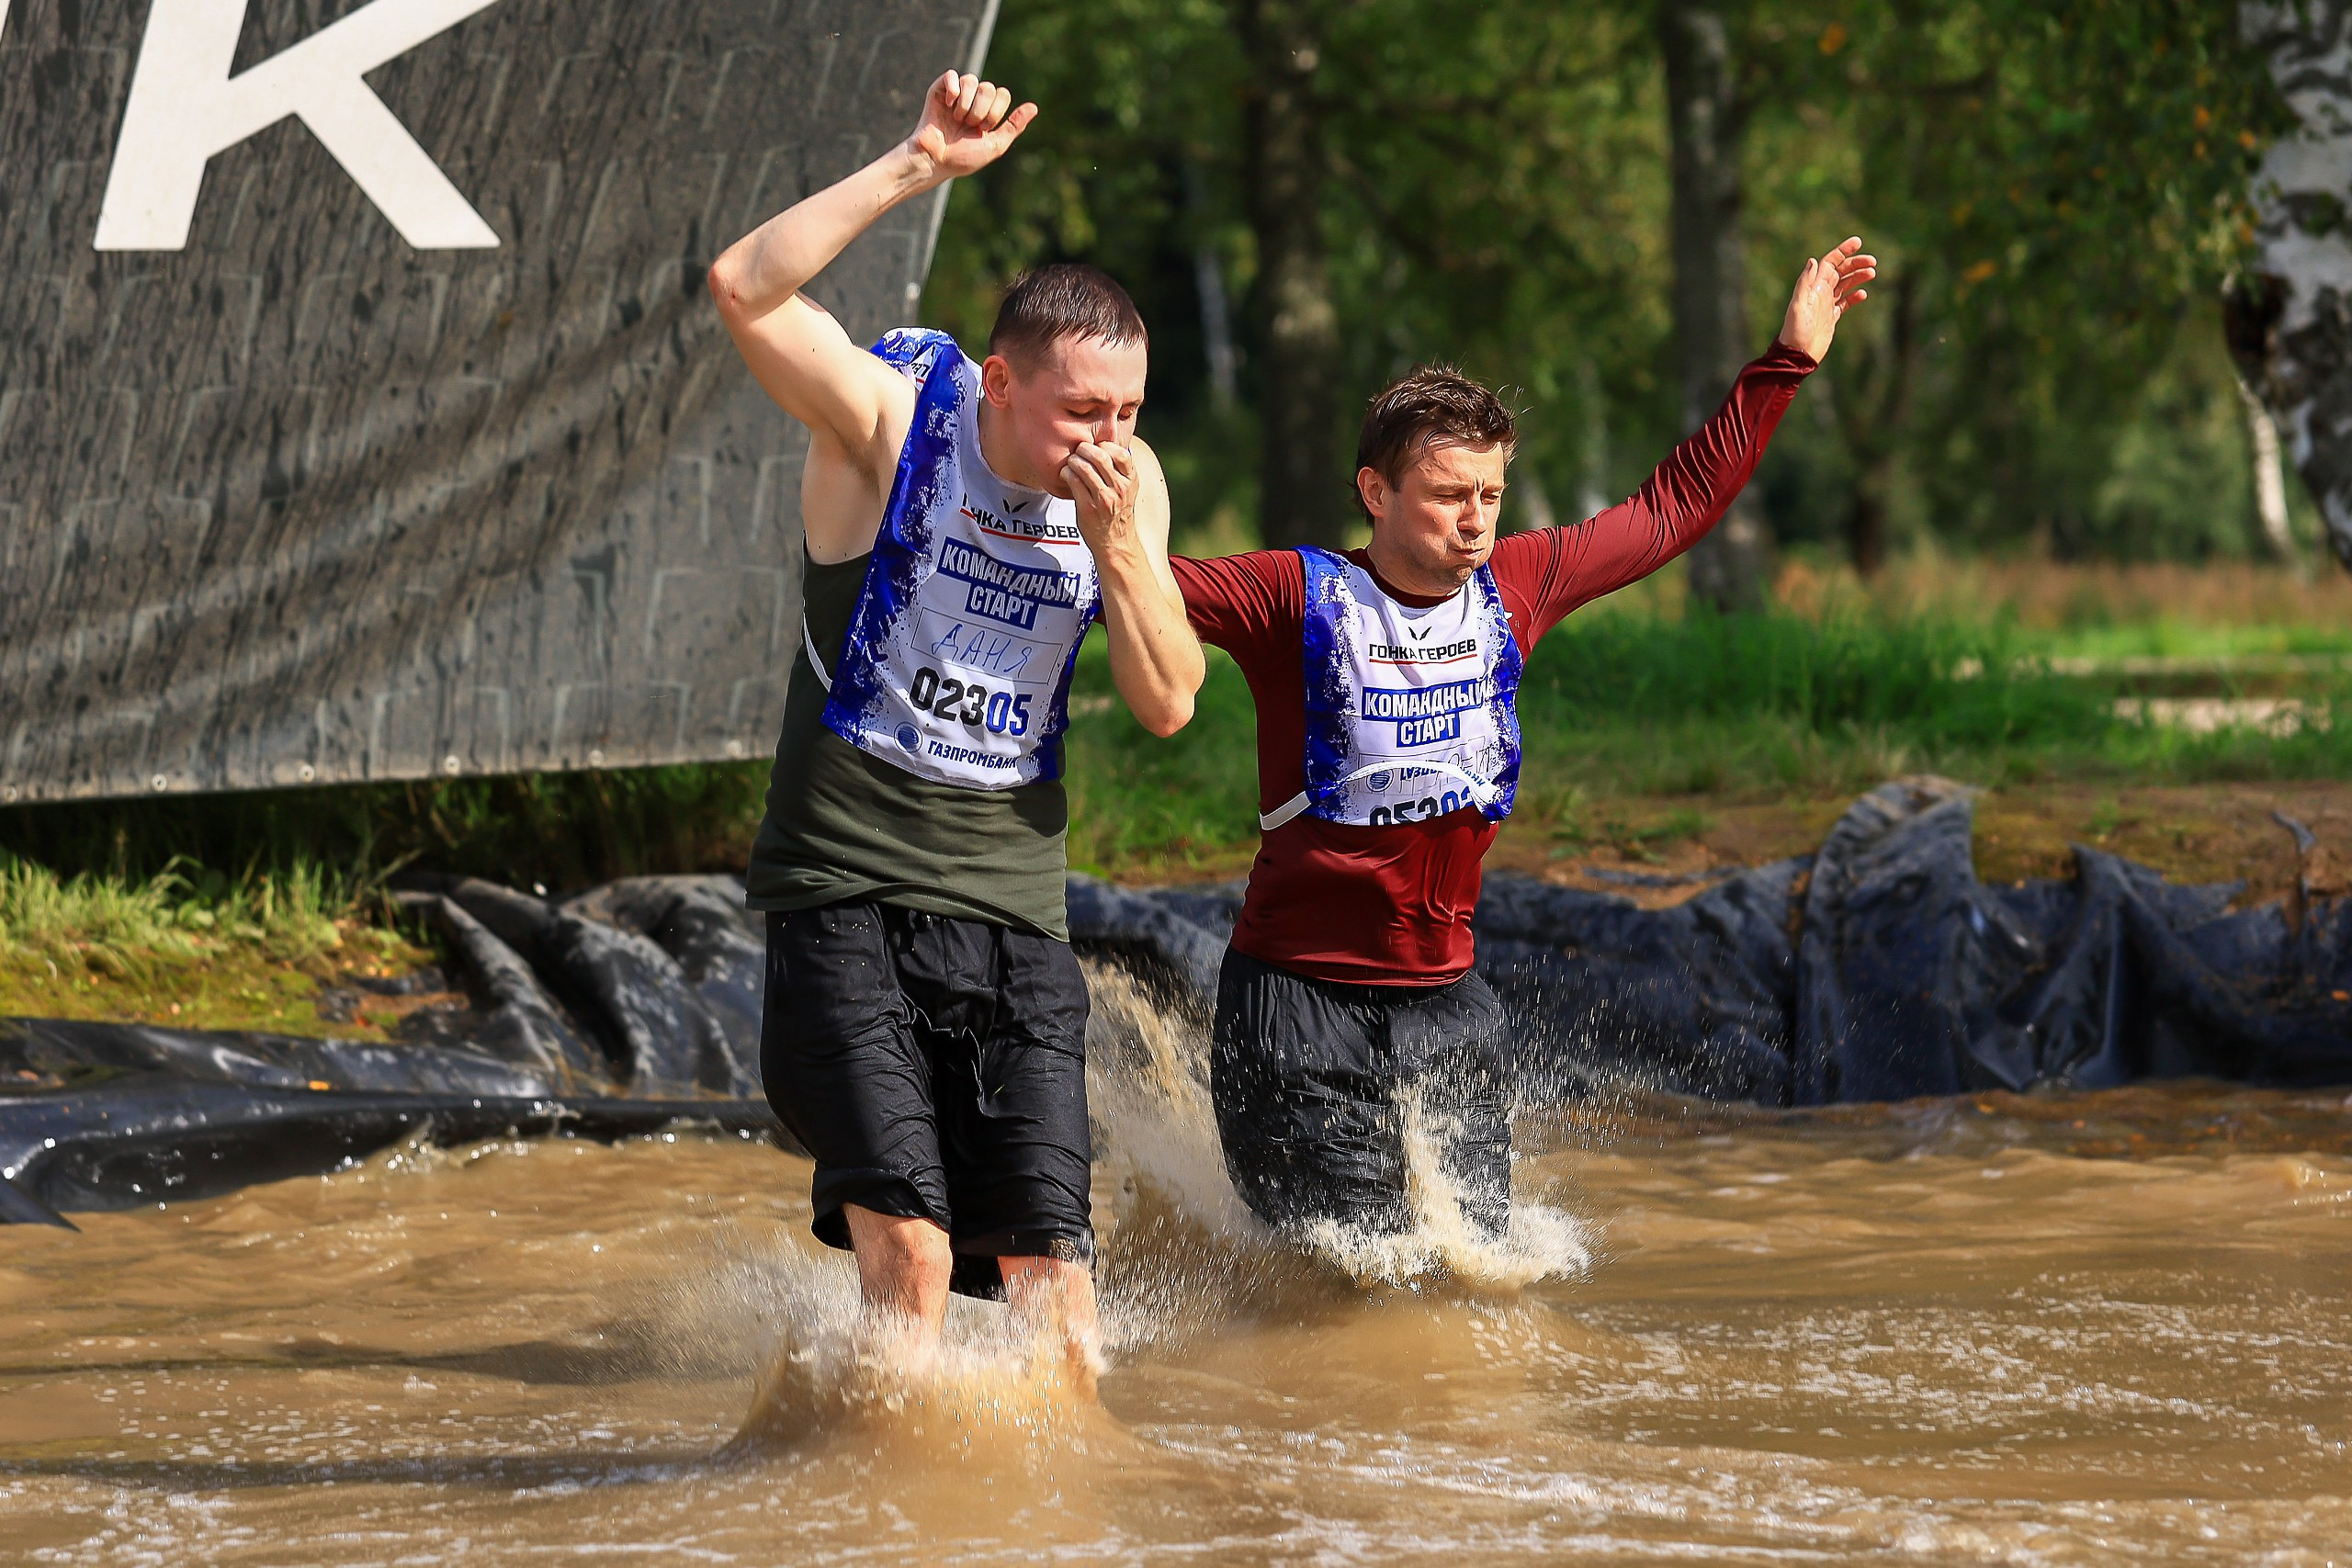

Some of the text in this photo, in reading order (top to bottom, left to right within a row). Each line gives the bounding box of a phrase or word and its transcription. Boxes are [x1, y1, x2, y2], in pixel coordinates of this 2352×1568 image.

[1012, 519, 1080, 538] ГЕРОЕВ
[940, 543, 1078, 603] КОМАНДНЫЙ
[970, 586, 1035, 625] СТАРТ
[932, 624, 1032, 678] ДАНЯ
[1368, 638, 1476, 660] ГОНКА ГЕРОЕВ
[909, 666, 1034, 737] 02305
[1400, 714, 1455, 745] СТАРТ
[927, 739, 1018, 770] ГАЗПРОМБАНК
